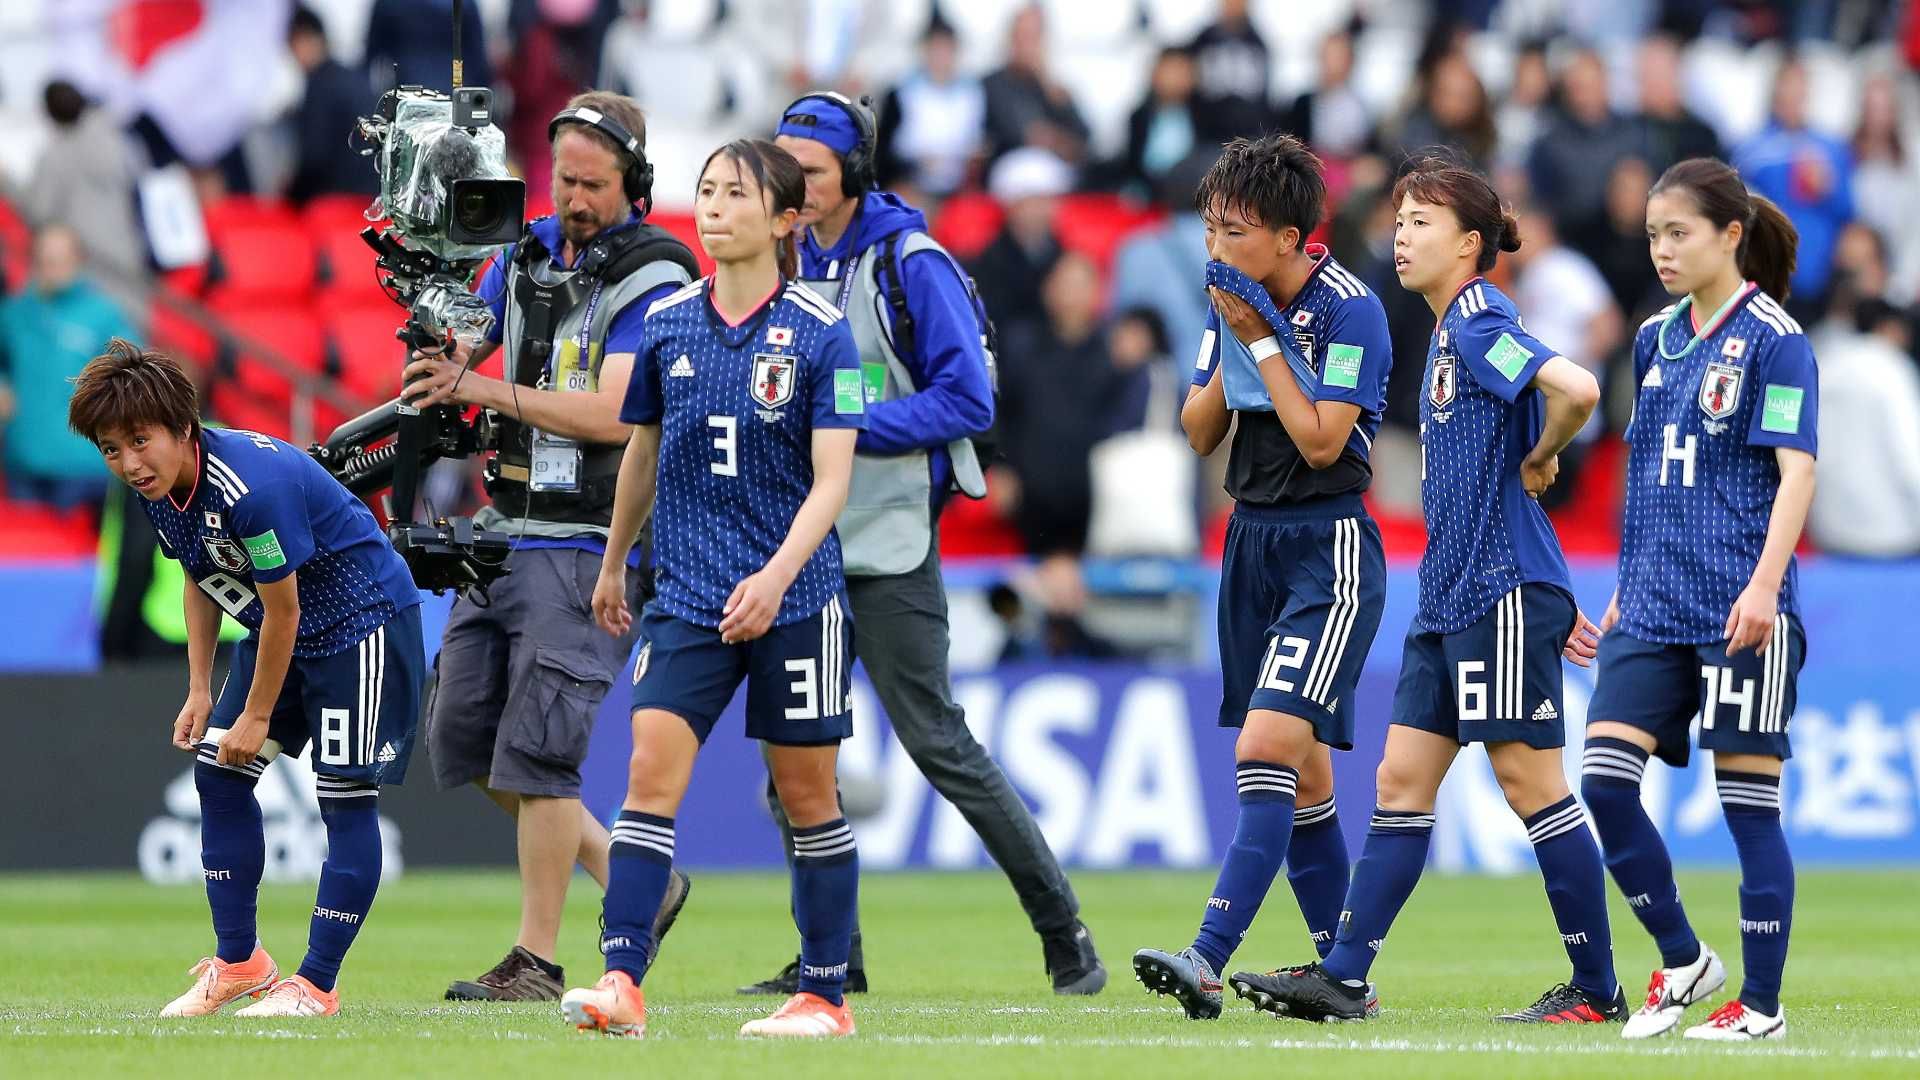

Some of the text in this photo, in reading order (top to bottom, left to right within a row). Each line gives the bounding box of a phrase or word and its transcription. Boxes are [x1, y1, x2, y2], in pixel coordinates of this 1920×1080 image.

[583, 306, 593, 332] FRANCE
[708, 415, 738, 477] 3
[1660, 423, 1697, 487] 14
[198, 572, 256, 617] 8
[784, 658, 819, 720] 3
[1257, 635, 1311, 693] 12
[1457, 661, 1488, 721] 6
[1701, 664, 1755, 733] 14
[320, 707, 350, 765] 8
[837, 672, 1214, 870] VISA
[313, 905, 360, 925] JAPAN
[804, 961, 849, 978] JAPAN
